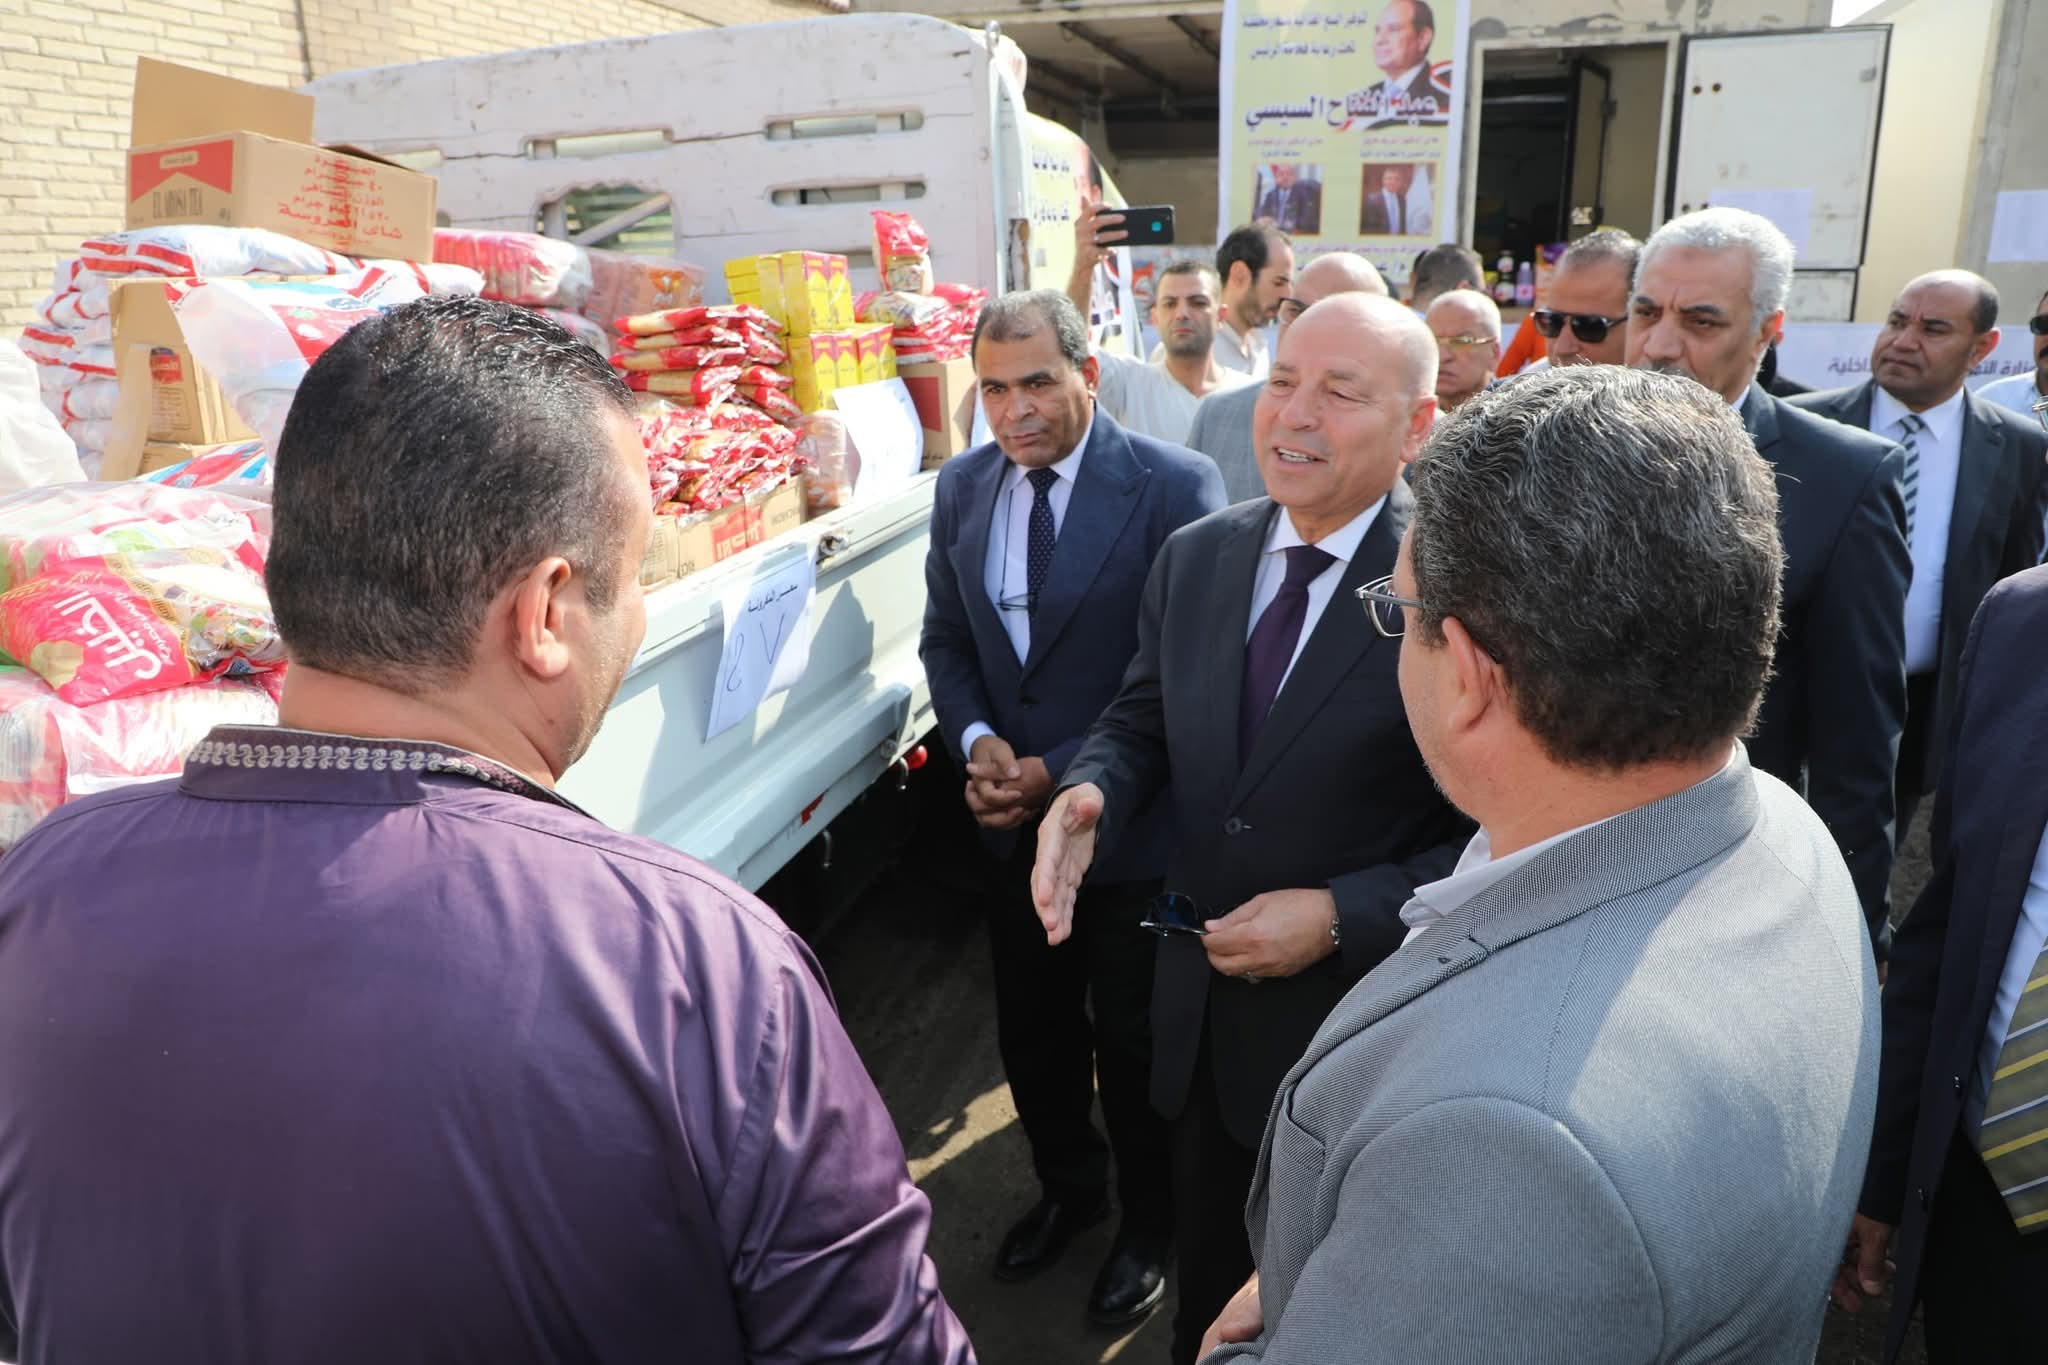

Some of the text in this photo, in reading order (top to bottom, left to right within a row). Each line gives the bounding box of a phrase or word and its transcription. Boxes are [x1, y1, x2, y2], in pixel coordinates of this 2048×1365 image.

[1246, 95, 1323, 131] السيسي
[1827, 356, 1873, 377] اخلية
[54, 590, 162, 680] الخليل
